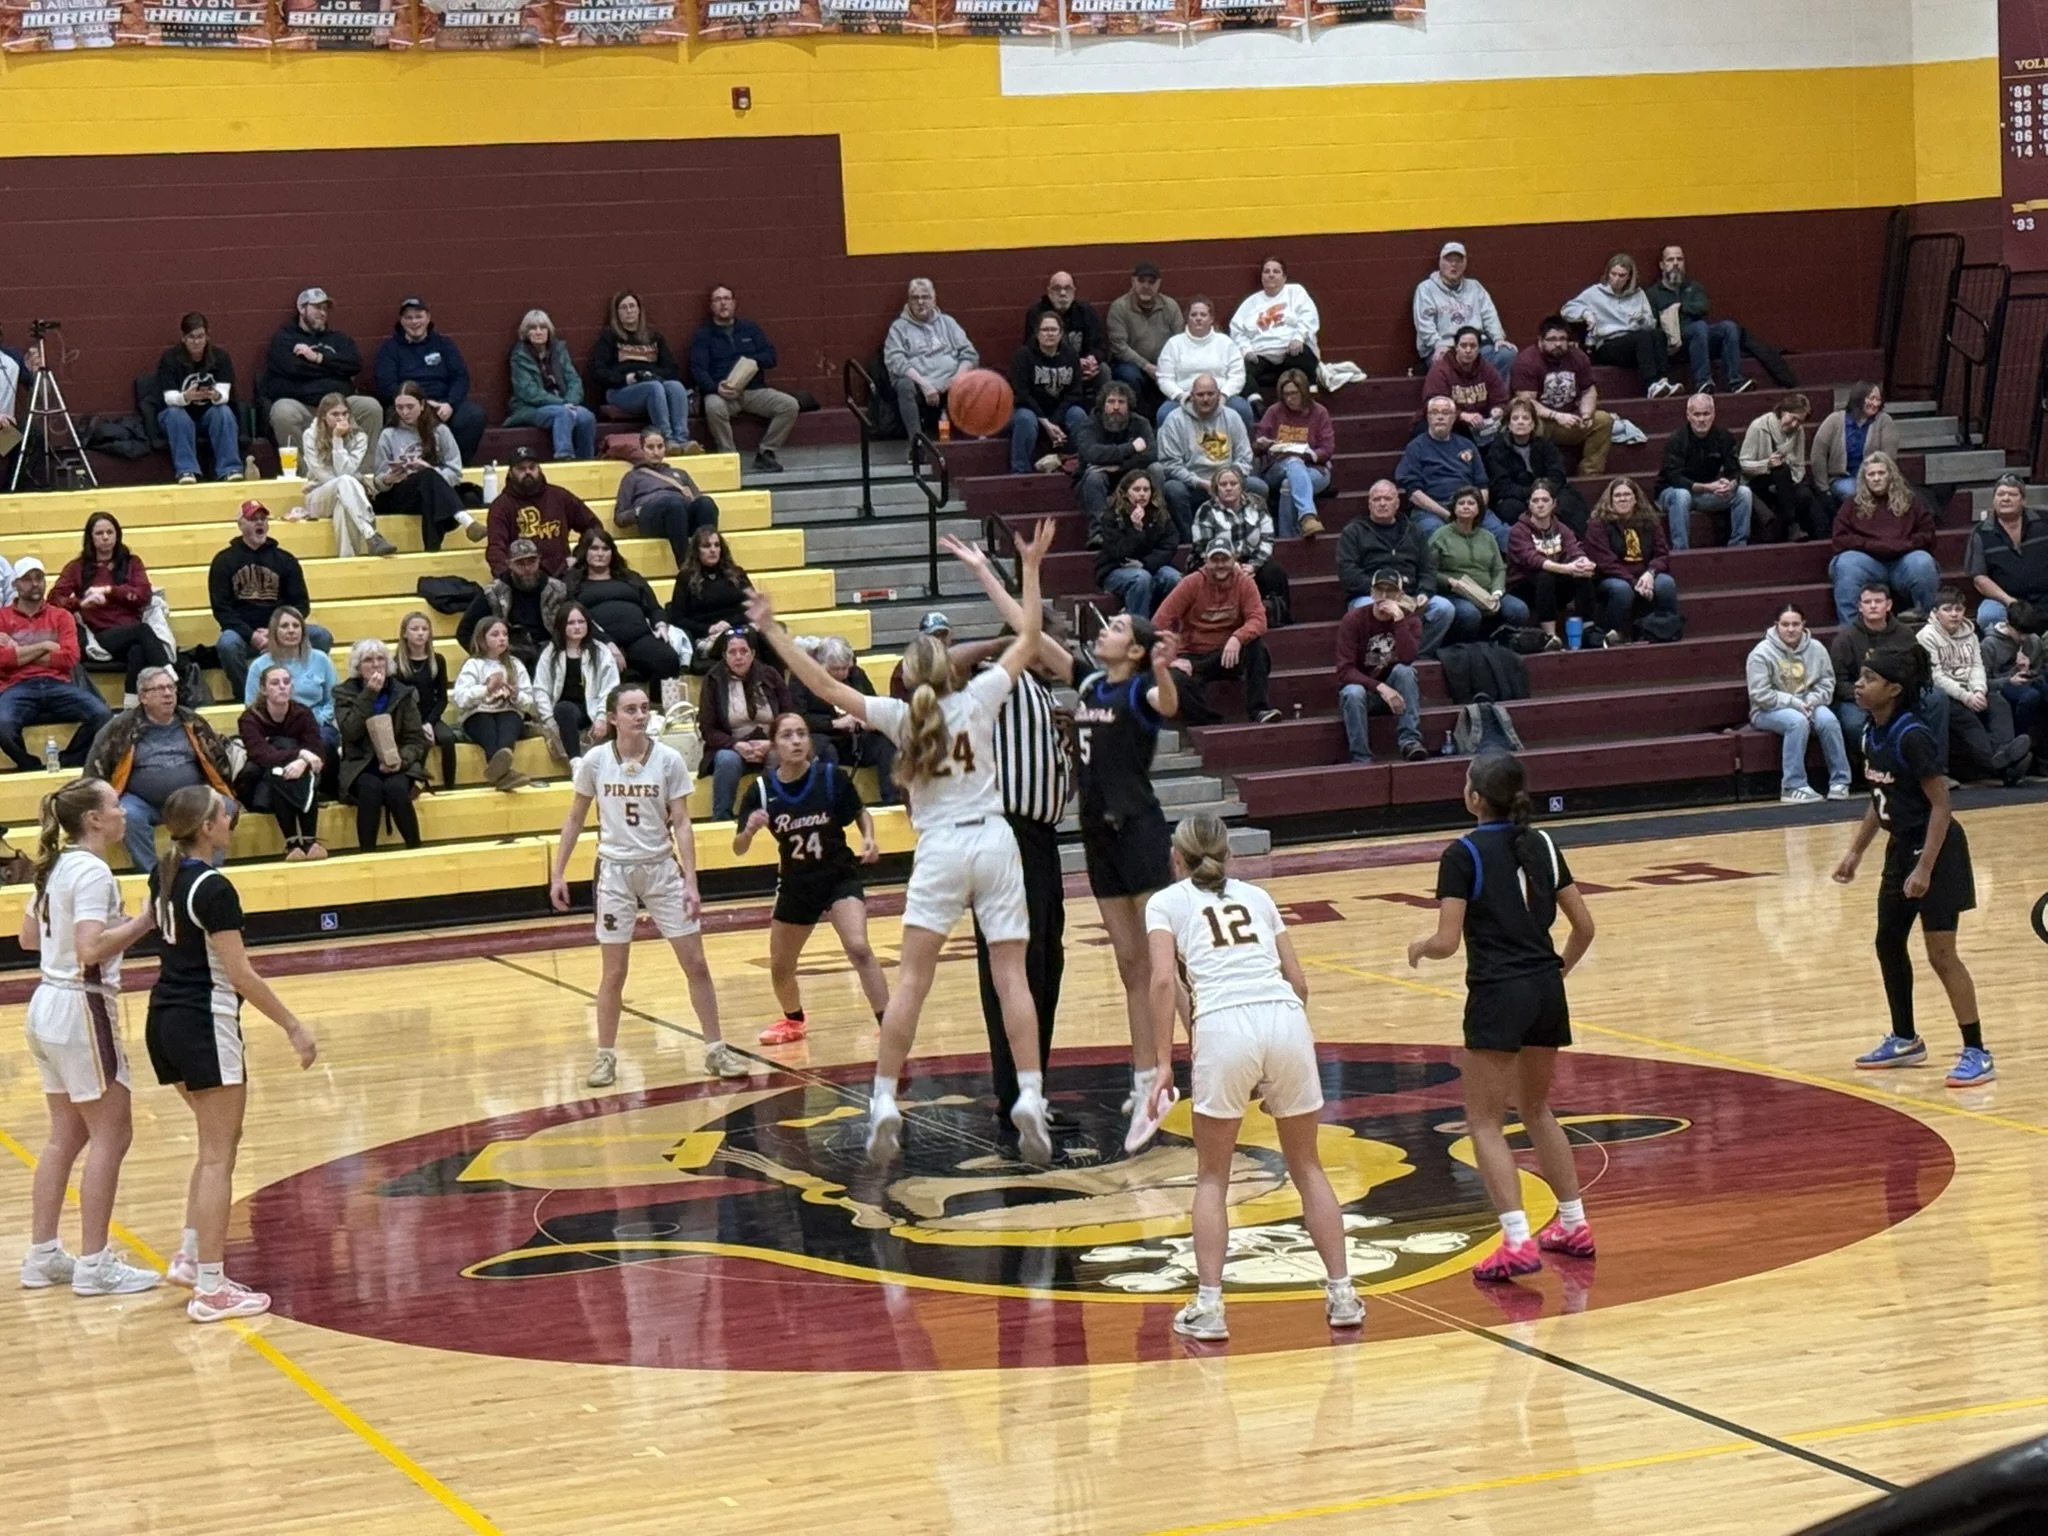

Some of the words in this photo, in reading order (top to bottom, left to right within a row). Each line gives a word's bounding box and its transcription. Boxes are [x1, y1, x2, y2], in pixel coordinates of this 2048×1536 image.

[162, 0, 235, 8] DEVON
[320, 1, 361, 10] JOE
[708, 0, 801, 17] WALTON
[955, 0, 1039, 14] MARTIN
[23, 7, 122, 28] MORRIS
[445, 11, 522, 26] SMITH
[565, 6, 675, 23] BUCKNER
[603, 783, 660, 797] PIRATES
[625, 802, 640, 827] 5
[774, 812, 830, 833] Ravens
[789, 832, 823, 860] 24
[1202, 903, 1261, 948] 12
